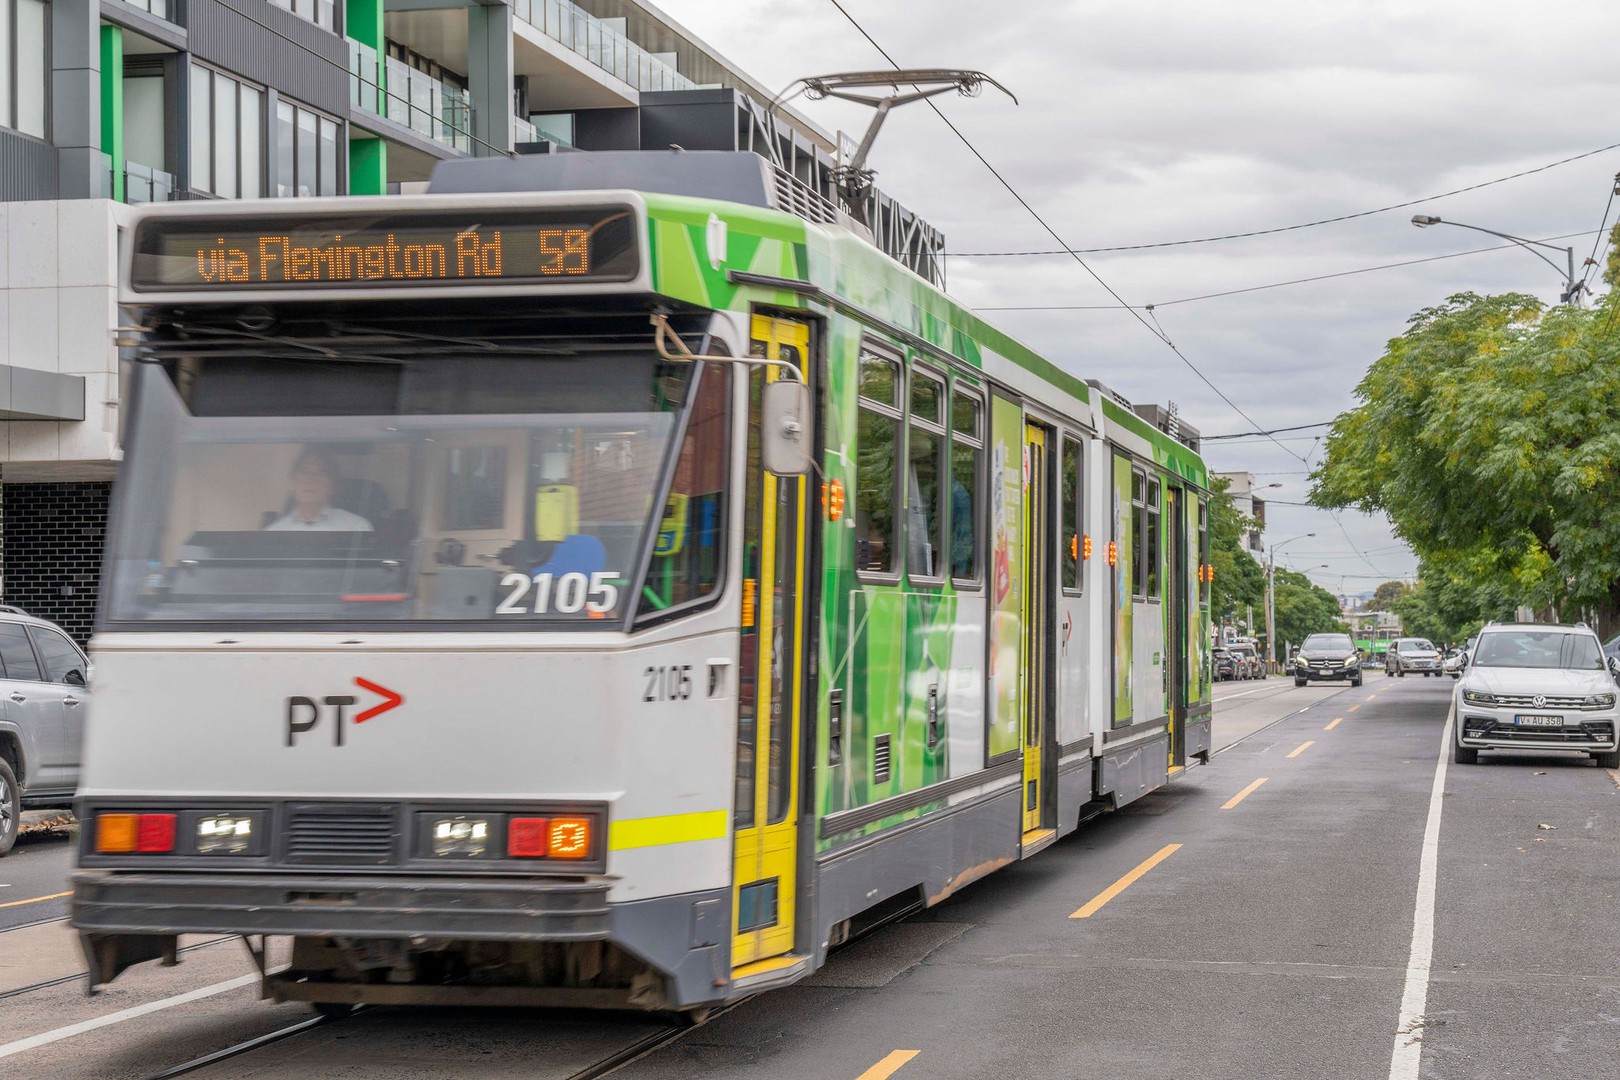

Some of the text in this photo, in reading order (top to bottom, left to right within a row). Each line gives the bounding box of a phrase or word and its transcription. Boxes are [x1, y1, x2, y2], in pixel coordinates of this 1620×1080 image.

[197, 228, 589, 282] via Flemington Rd 59
[495, 571, 620, 614] 2105
[642, 665, 693, 702] 2105
